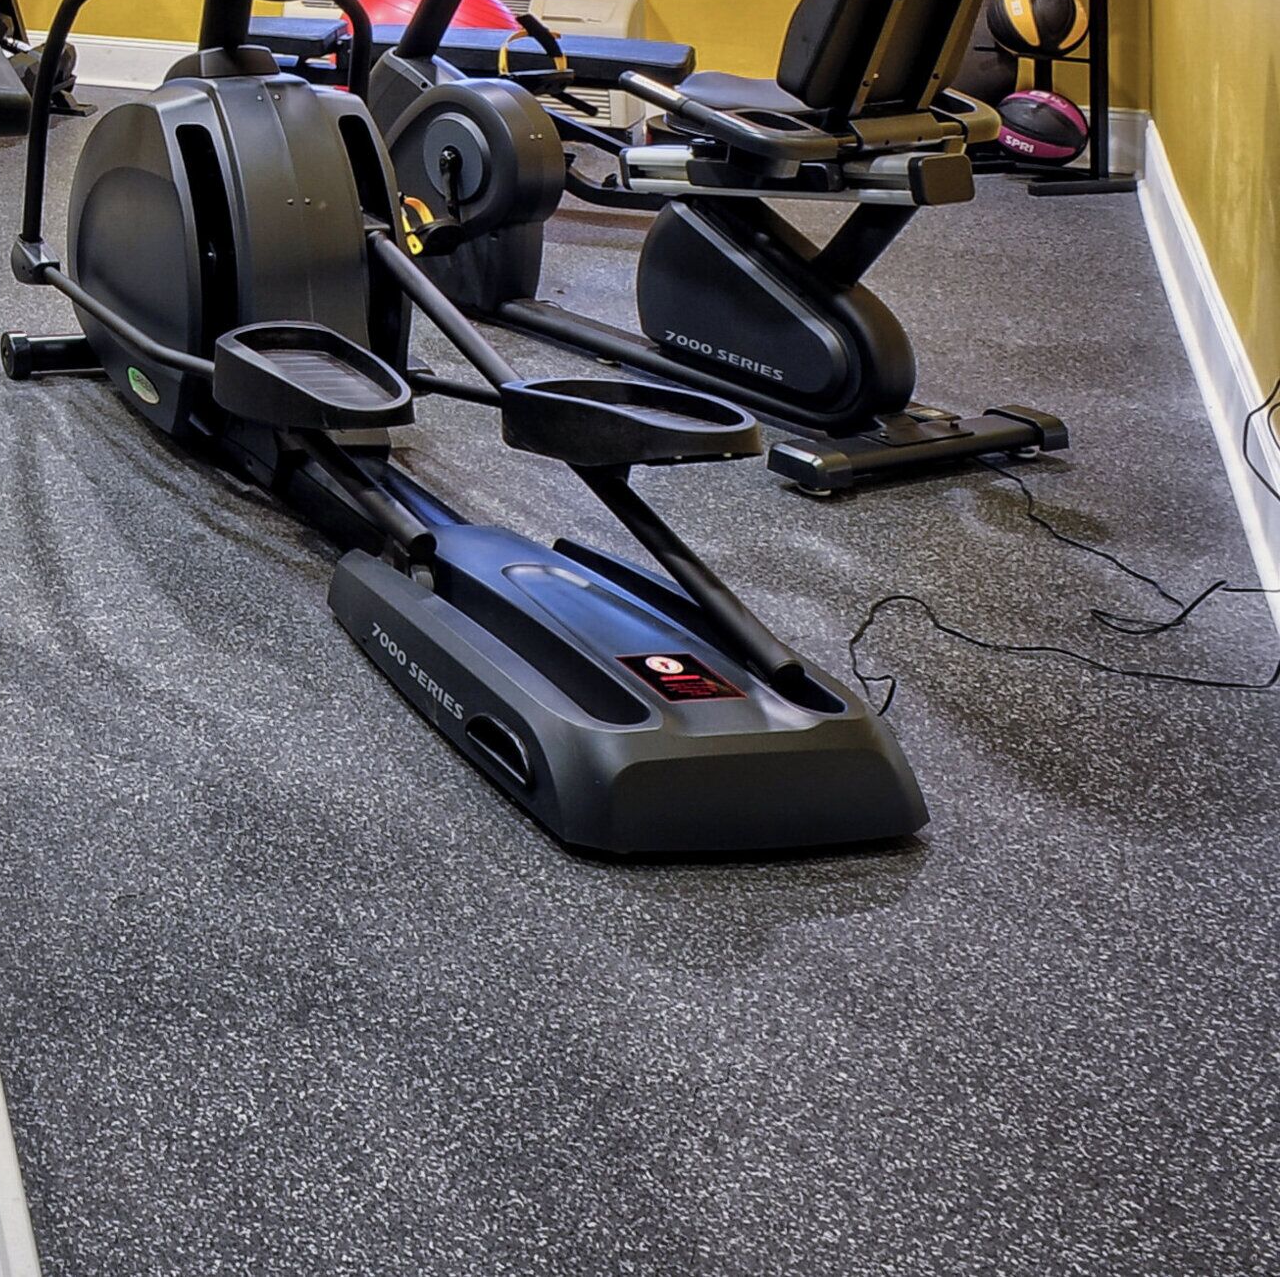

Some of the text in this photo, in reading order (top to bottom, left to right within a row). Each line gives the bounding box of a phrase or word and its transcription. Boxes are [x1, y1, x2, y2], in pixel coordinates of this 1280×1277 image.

[1005, 135, 1034, 153] SPRI
[664, 330, 784, 381] 7000 SERIES
[372, 622, 464, 720] 7000 SERIES
